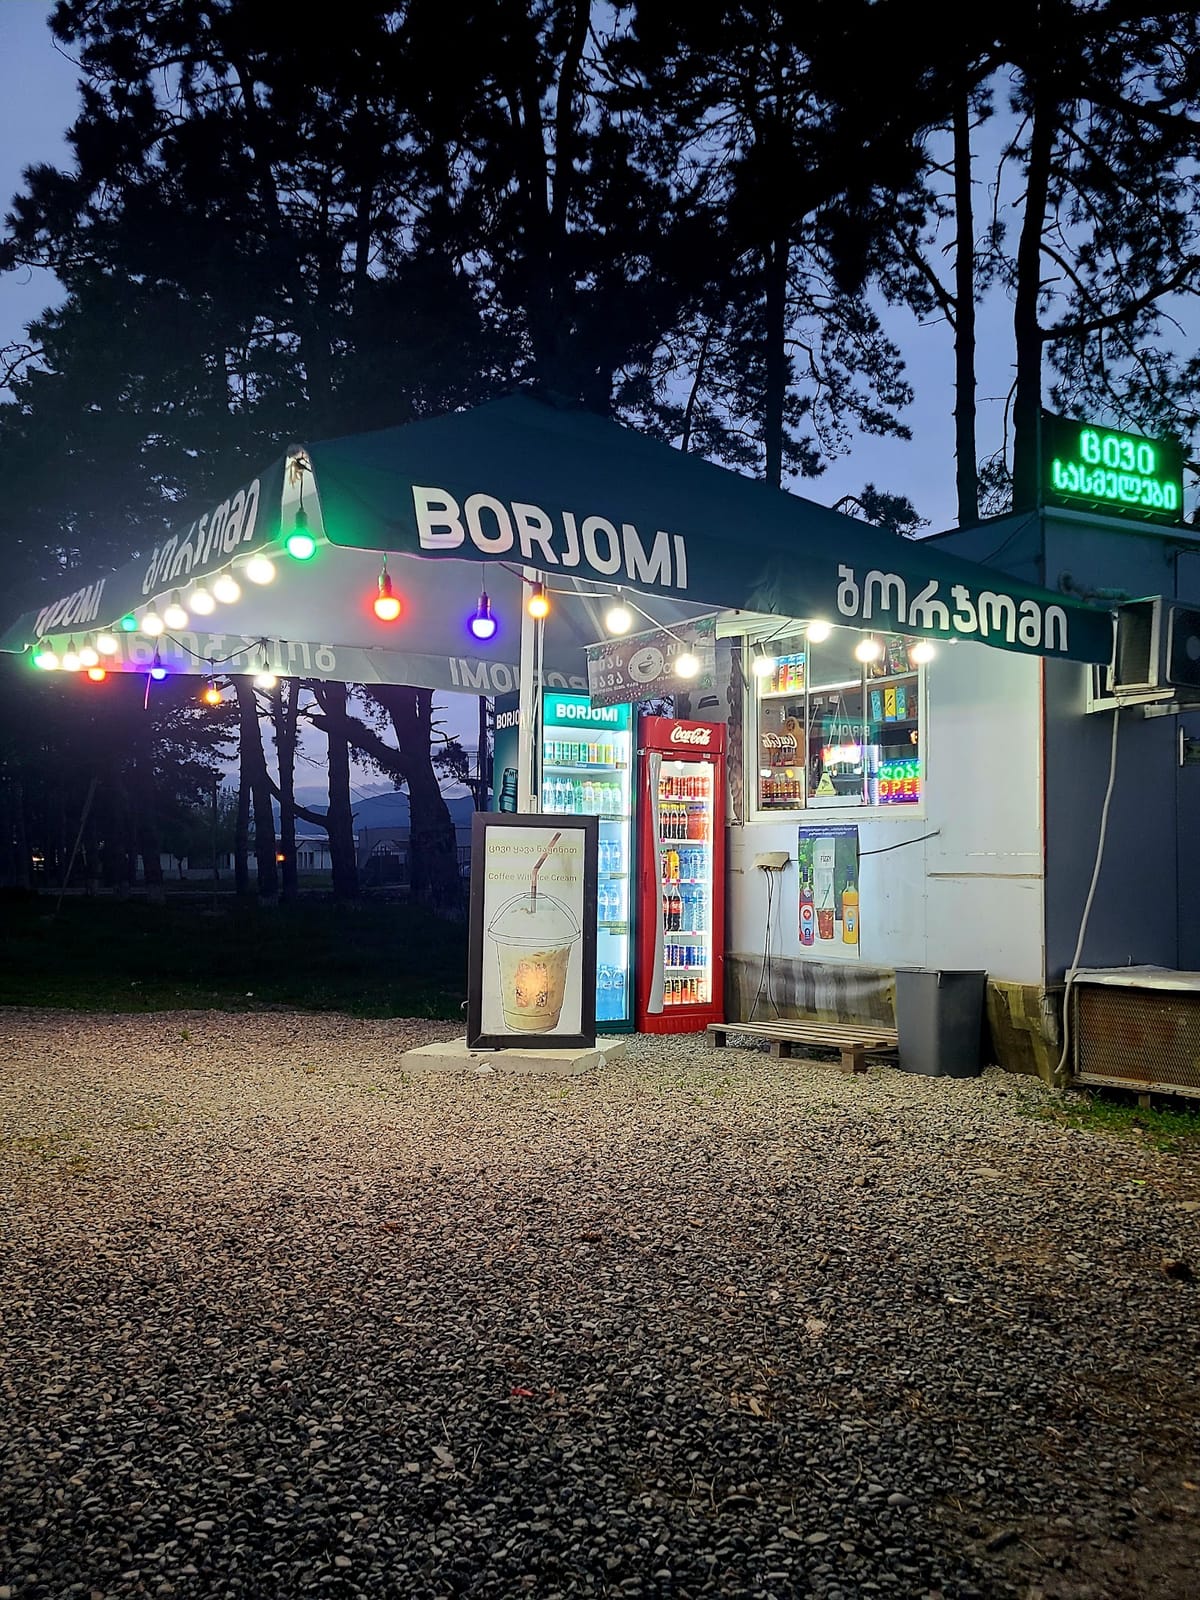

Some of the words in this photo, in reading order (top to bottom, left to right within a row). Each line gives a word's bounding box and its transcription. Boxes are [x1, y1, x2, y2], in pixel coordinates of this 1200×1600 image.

[1081, 429, 1156, 475] ცივი
[1052, 458, 1177, 511] სასმელები
[412, 485, 688, 589] BORJOMI
[837, 564, 1069, 652] ბორჯომი
[556, 703, 618, 722] BORJOMI
[489, 872, 515, 881] Coffee
[538, 873, 549, 881] Ice
[551, 873, 577, 882] Cream
